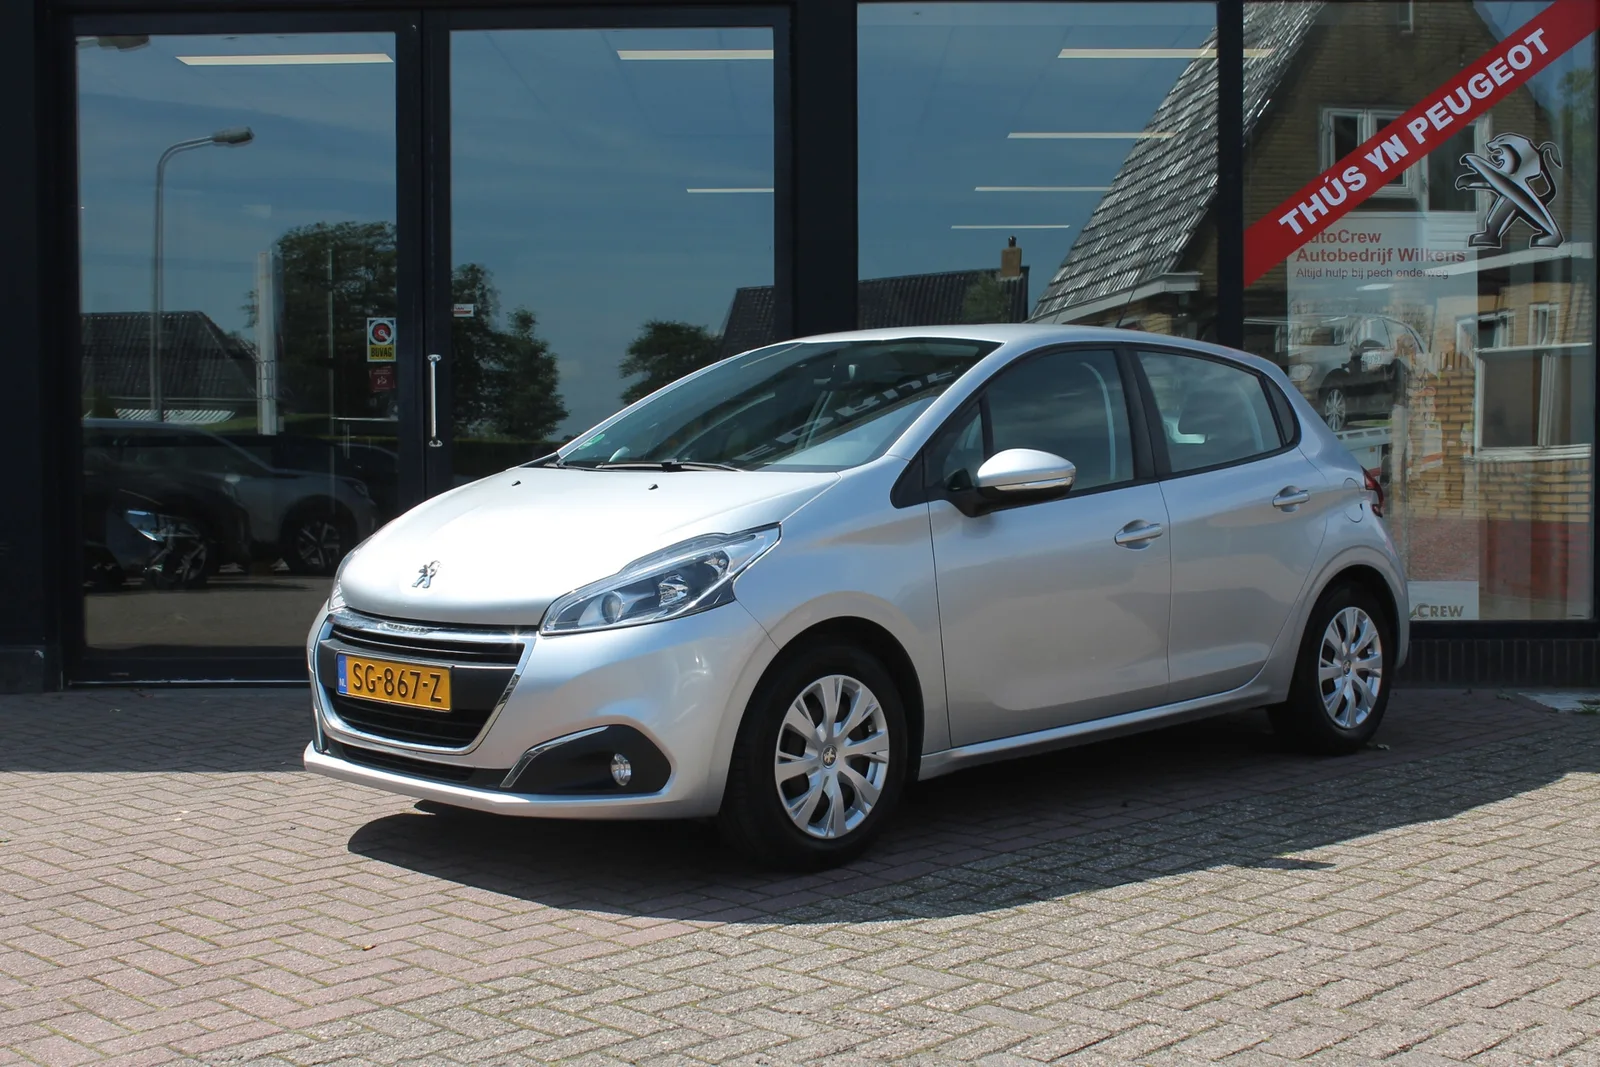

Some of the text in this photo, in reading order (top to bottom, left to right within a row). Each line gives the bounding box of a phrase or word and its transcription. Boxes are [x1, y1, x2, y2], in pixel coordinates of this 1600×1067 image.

[1278, 27, 1549, 236] THÚS YN PEUGEOT
[1306, 229, 1382, 244] utoCrew
[1296, 248, 1466, 265] Autobedrijf Wilkens
[1296, 268, 1449, 279] Altijd hulp bij pech onderweg
[339, 677, 347, 687] NL
[353, 661, 443, 703] SG-867-Z
